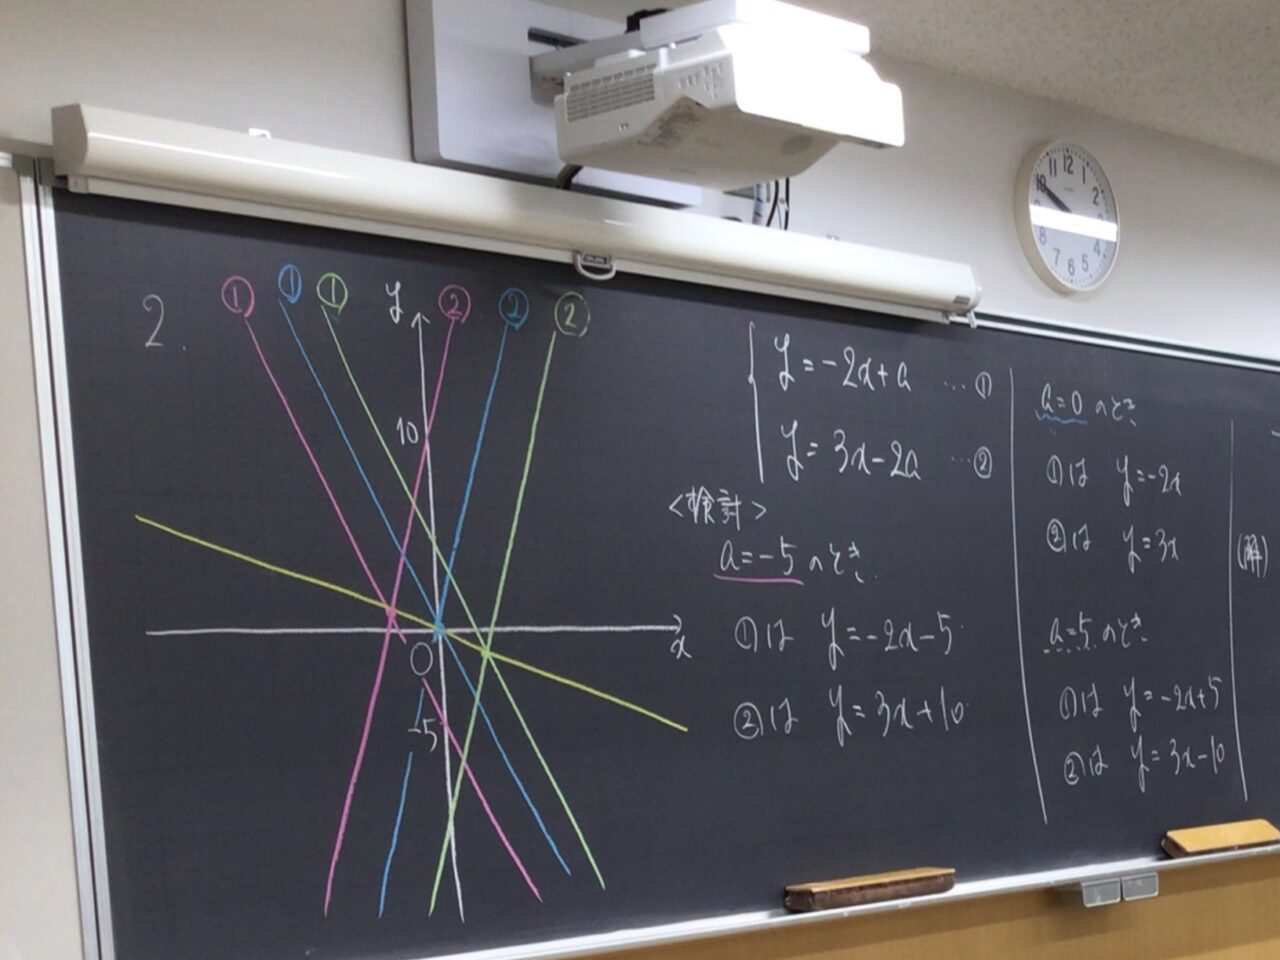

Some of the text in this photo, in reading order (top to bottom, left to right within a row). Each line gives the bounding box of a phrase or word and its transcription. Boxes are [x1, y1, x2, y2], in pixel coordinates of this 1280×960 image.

[1049, 158, 1058, 178] 11
[1063, 154, 1074, 175] 12
[1036, 174, 1047, 194] 10
[1082, 166, 1087, 185] 1
[1092, 187, 1100, 206] 2
[1039, 226, 1047, 245] 8
[1053, 248, 1061, 266] 7
[1093, 239, 1101, 257] 4
[1067, 258, 1076, 277] 6
[1081, 254, 1089, 273] 5
[386, 280, 404, 323] y
[397, 416, 419, 446] 10
[671, 635, 693, 659] x
